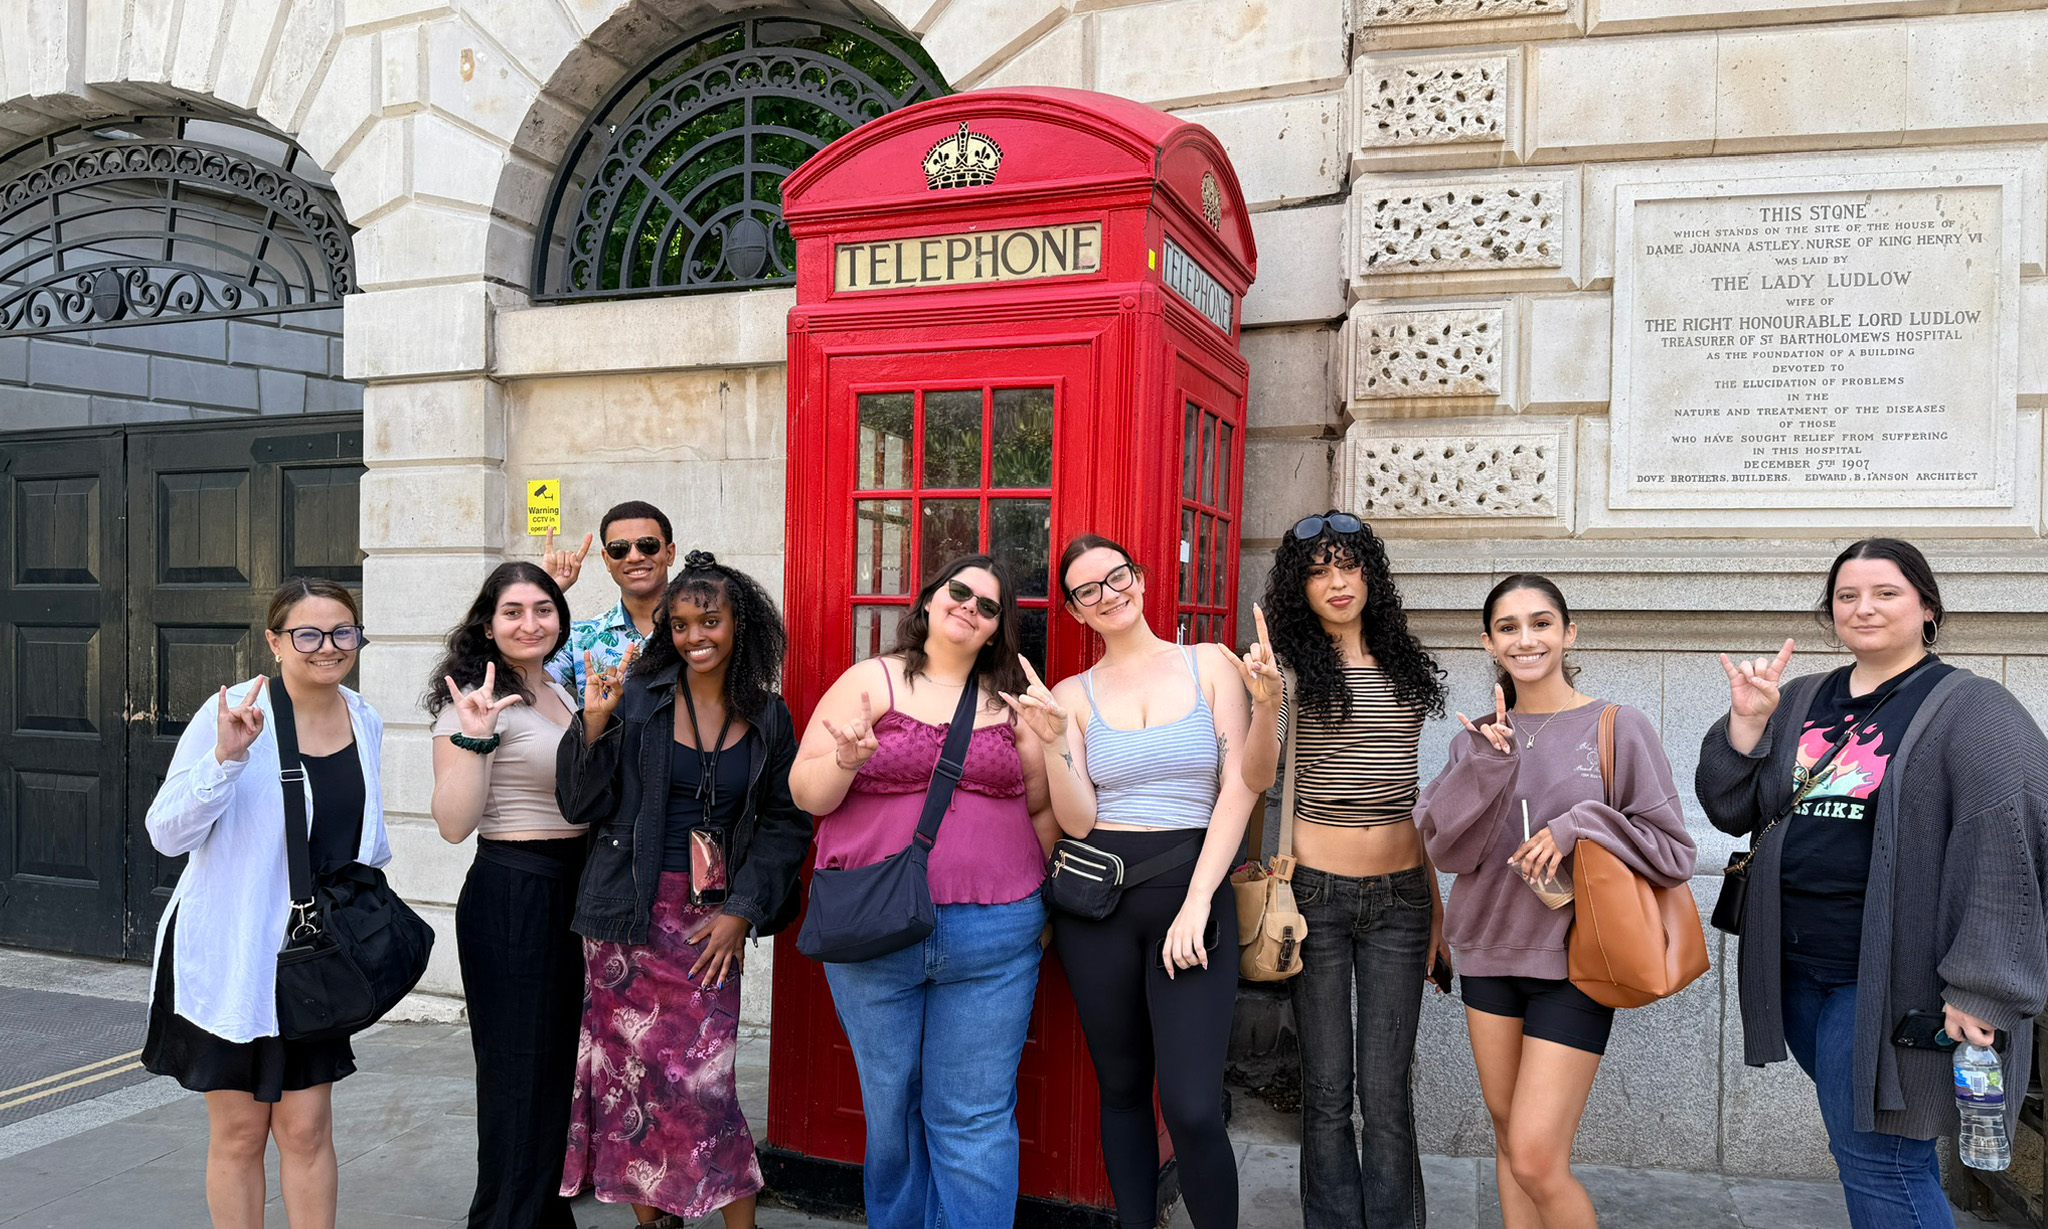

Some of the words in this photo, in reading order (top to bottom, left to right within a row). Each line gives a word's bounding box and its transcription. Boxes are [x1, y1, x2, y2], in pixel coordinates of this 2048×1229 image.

[1759, 206, 1801, 222] THIS
[1810, 204, 1867, 220] STONE
[1673, 229, 1710, 238] WHICH
[1715, 228, 1759, 236] STANDS
[1765, 227, 1780, 235] ON
[1785, 226, 1808, 234] THE
[1815, 225, 1840, 233] SITE
[1867, 222, 1890, 231] THE
[1895, 221, 1935, 230] HOUSE
[1941, 219, 1955, 228] OF
[1646, 244, 1683, 256] DAME
[1690, 243, 1740, 253] JOANNA
[1806, 238, 1851, 249] NURSE
[1857, 237, 1873, 247] OF
[1879, 236, 1912, 246] KING
[1917, 234, 1962, 245] HENRY
[1968, 233, 1982, 243] VI
[840, 226, 1097, 287] TELEPHONE
[1802, 257, 1828, 265] LAID
[1833, 256, 1848, 264] BY
[1163, 239, 1230, 331] TELEPHONE
[1711, 276, 1749, 291] THE
[1761, 274, 1815, 290] LADY
[1827, 271, 1912, 288] LUDLOW
[1645, 319, 1676, 332] THE
[1682, 317, 1732, 331] RIGHT
[1739, 313, 1851, 331] HONOURABLE
[1858, 313, 1902, 327] LORD
[1910, 310, 1981, 326] LUDLOW
[1662, 336, 1735, 347] TREASURER
[1739, 335, 1755, 346] OF
[1780, 331, 1890, 345] BARTHOLOMEWS
[1896, 330, 1962, 342] HOSPITAL
[1706, 352, 1720, 360] AS
[1752, 350, 1824, 359] FOUNDATION
[1860, 348, 1915, 356] BUILDING
[1772, 364, 1825, 372] DEVOTED
[1715, 380, 1737, 389] THE
[1743, 379, 1816, 388] ELUCIDATION
[1822, 378, 1836, 386] OF
[1842, 377, 1905, 385] PROBLEMS
[1787, 393, 1800, 401] IN
[1675, 409, 1720, 417] NATURE
[1726, 408, 1750, 416] AND
[1757, 407, 1828, 415] TREATMENT
[1856, 406, 1879, 414] THE
[1886, 405, 1945, 413] DISEASES
[1799, 420, 1836, 428] THOSE
[1704, 435, 1733, 443] HAVE
[1741, 434, 1787, 442] SOUGHT
[1794, 434, 1836, 442] RELIEF
[1842, 433, 1874, 441] FROM
[1882, 432, 1948, 441] SUFFERING
[1772, 447, 1798, 455] THIS
[1744, 461, 1810, 469] DECEMBER
[1842, 460, 1870, 470] 1907
[1637, 475, 1665, 483] DOVE
[1916, 472, 1978, 480] ARCHITECT
[529, 506, 559, 516] Warning
[1813, 801, 1865, 819] LIKE
